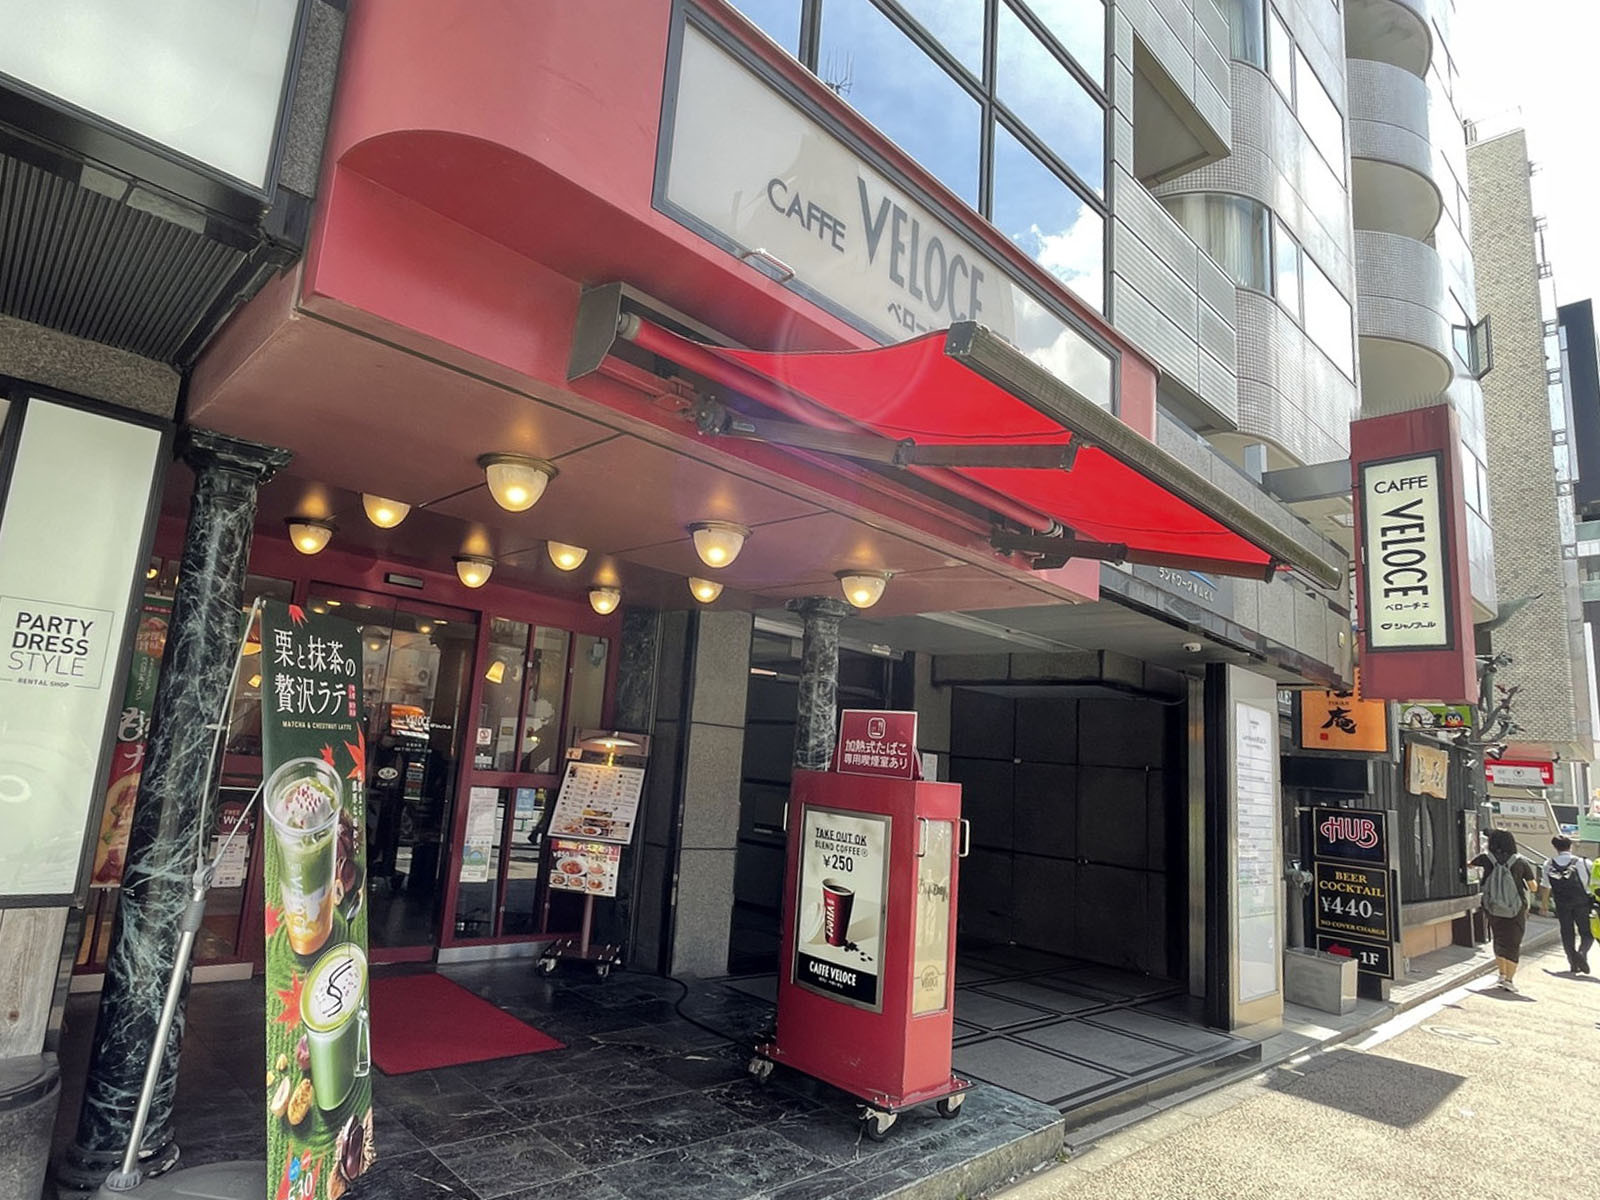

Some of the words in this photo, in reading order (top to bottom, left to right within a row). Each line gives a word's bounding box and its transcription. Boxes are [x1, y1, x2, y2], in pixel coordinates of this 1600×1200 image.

[768, 178, 847, 253] CAFFE
[857, 176, 985, 323] VELOCE
[888, 303, 932, 333] ベロー
[1374, 475, 1429, 494] CAFFE
[1381, 498, 1429, 598] VELOCE
[16, 611, 94, 637] PARTY
[12, 631, 89, 656] DRESS
[273, 628, 356, 677] 栗と抹茶の
[8, 650, 87, 677] STYLE
[274, 673, 346, 716] 贅沢ラテ
[845, 740, 907, 756] 加熱式たばこ
[844, 753, 908, 770] 専用喫煙室あり
[815, 827, 835, 840] TAKE
[836, 831, 853, 843] OUT
[854, 834, 867, 846] OK
[1320, 816, 1378, 848] HUB
[815, 840, 834, 851] BLEND
[835, 844, 860, 856] COFFEE
[823, 854, 853, 872] ¥250
[1319, 880, 1385, 898] COCKTAIL
[1335, 871, 1367, 883] BEER
[1360, 952, 1380, 966] 1F
[809, 961, 829, 977] CAFFE
[830, 966, 857, 986] VELOCE
